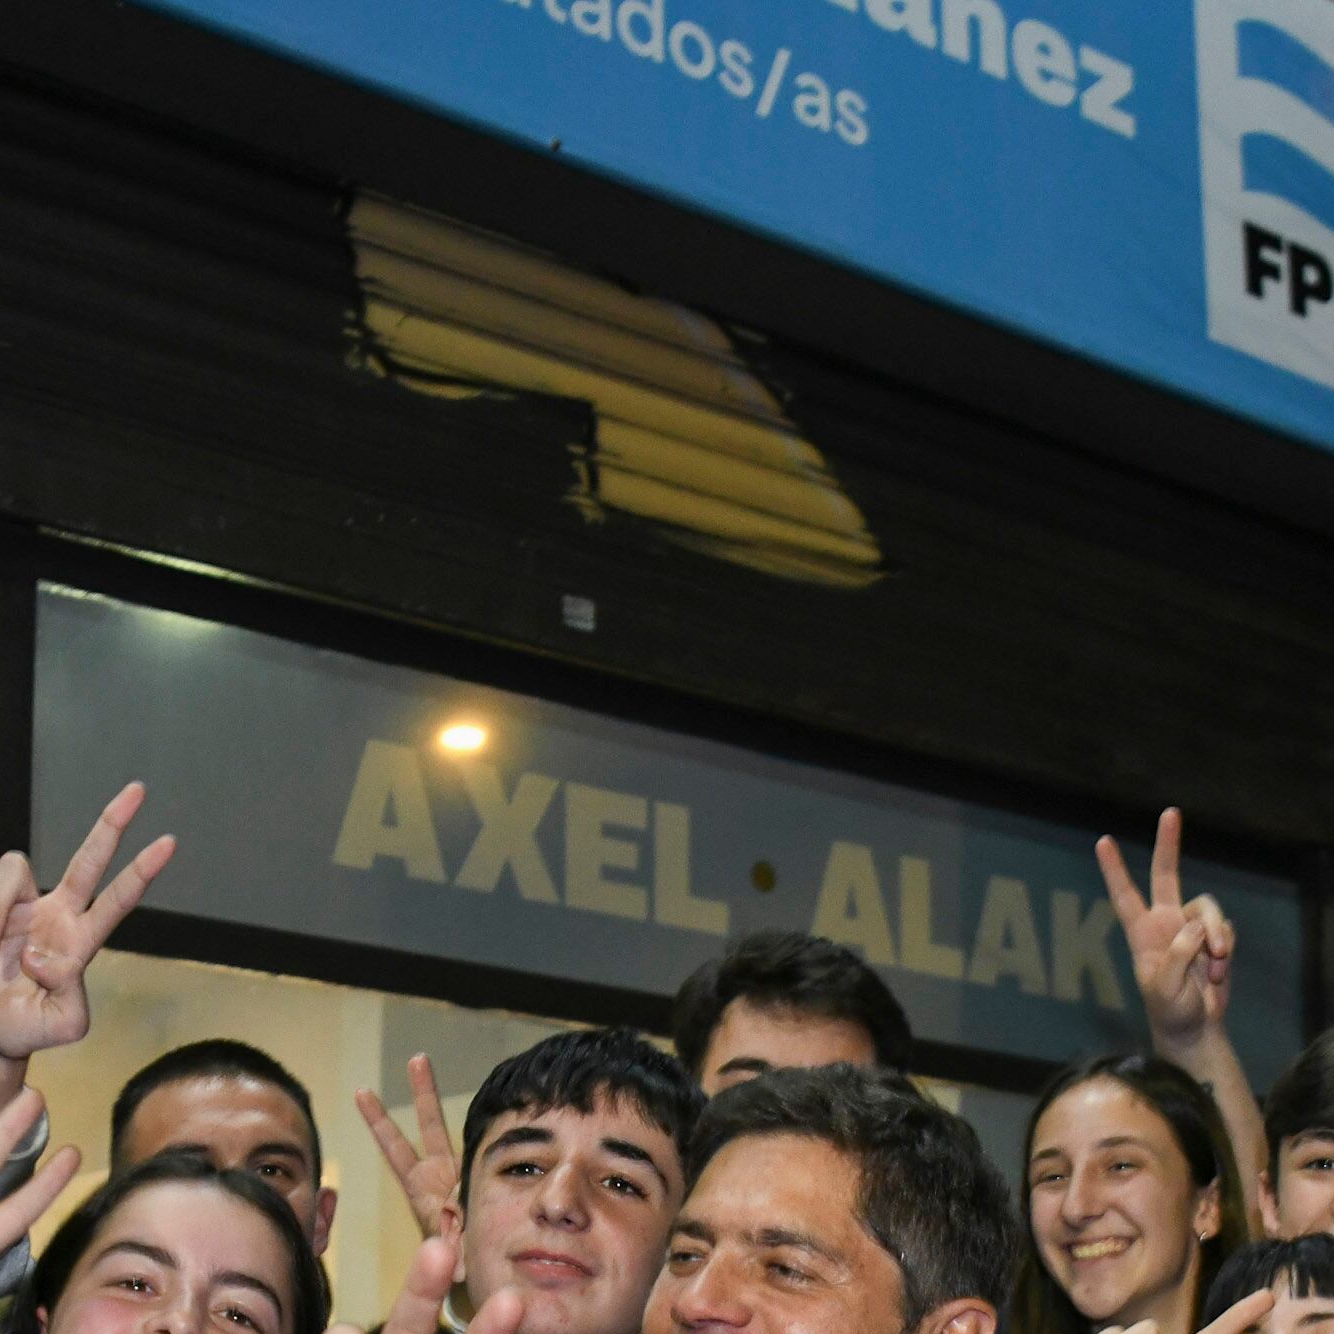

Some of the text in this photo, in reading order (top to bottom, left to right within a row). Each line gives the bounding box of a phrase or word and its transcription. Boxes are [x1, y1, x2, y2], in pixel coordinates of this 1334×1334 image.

[1242, 219, 1334, 319] FP
[331, 739, 1126, 1010] AXEL ALAK
